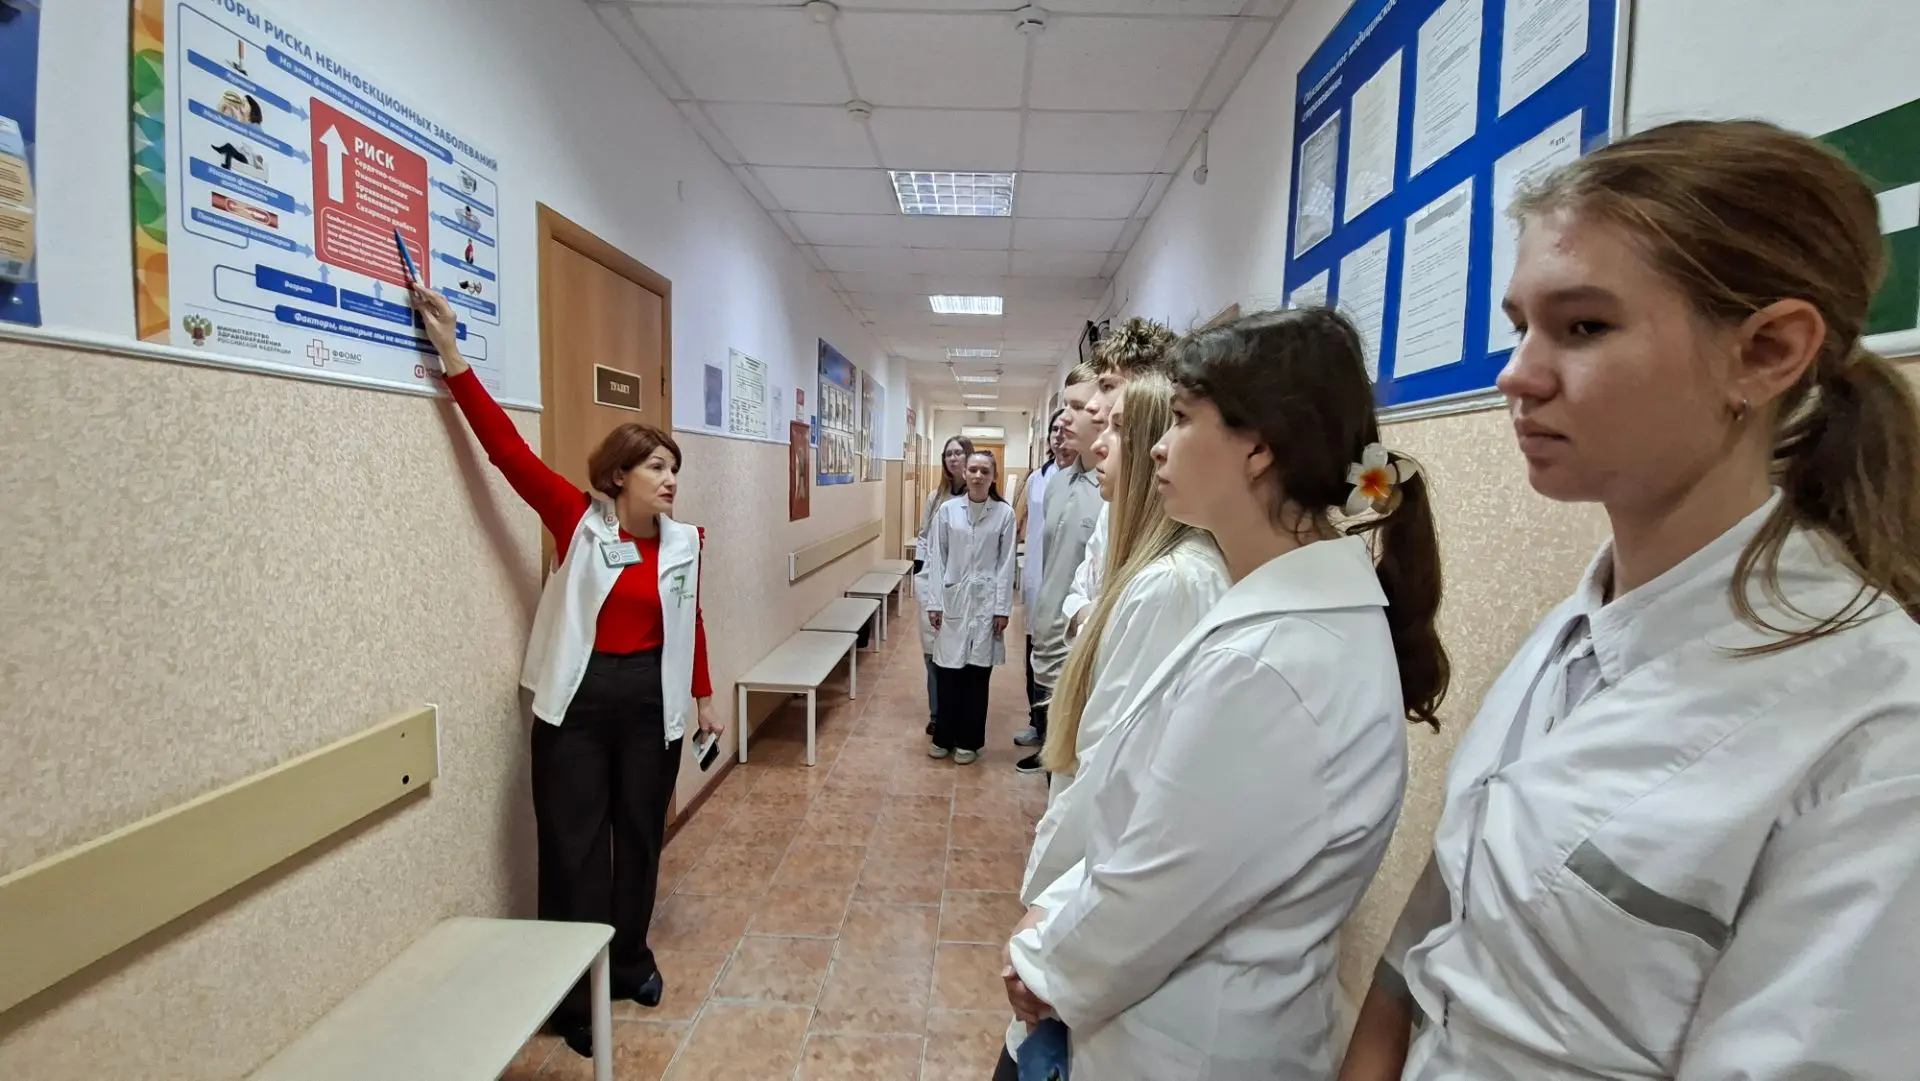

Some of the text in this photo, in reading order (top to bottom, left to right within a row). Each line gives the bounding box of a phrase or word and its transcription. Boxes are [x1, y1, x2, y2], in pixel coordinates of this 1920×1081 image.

[217, 0, 497, 171] ОРЫ РИСКА НЕИНФЕКЦИОННЫХ ЗАБОЛЕВАНИЙ
[354, 136, 395, 171] РИСК
[294, 312, 338, 330] Факторы,
[338, 322, 373, 338] которые
